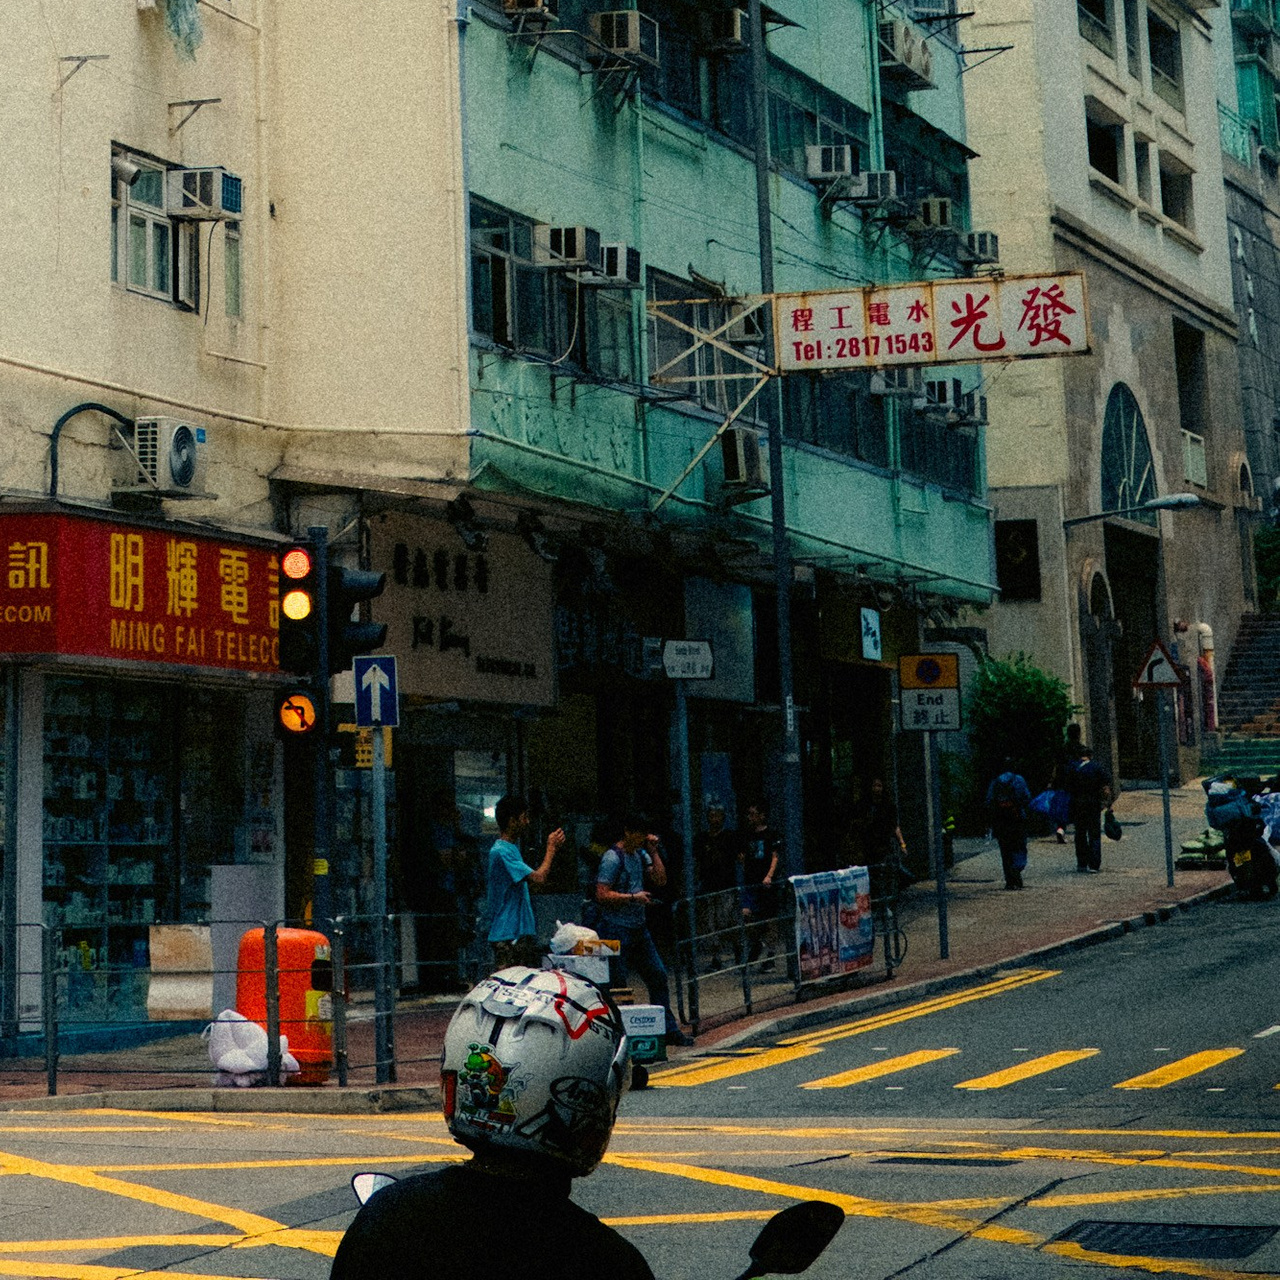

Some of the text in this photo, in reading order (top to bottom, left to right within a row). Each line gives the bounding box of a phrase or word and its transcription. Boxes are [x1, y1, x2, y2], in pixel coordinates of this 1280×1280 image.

[835, 336, 880, 359] 2817
[884, 332, 934, 354] 1543
[110, 619, 280, 666] MING FAI TELECO
[916, 694, 944, 706] End
[913, 710, 950, 725] 終止
